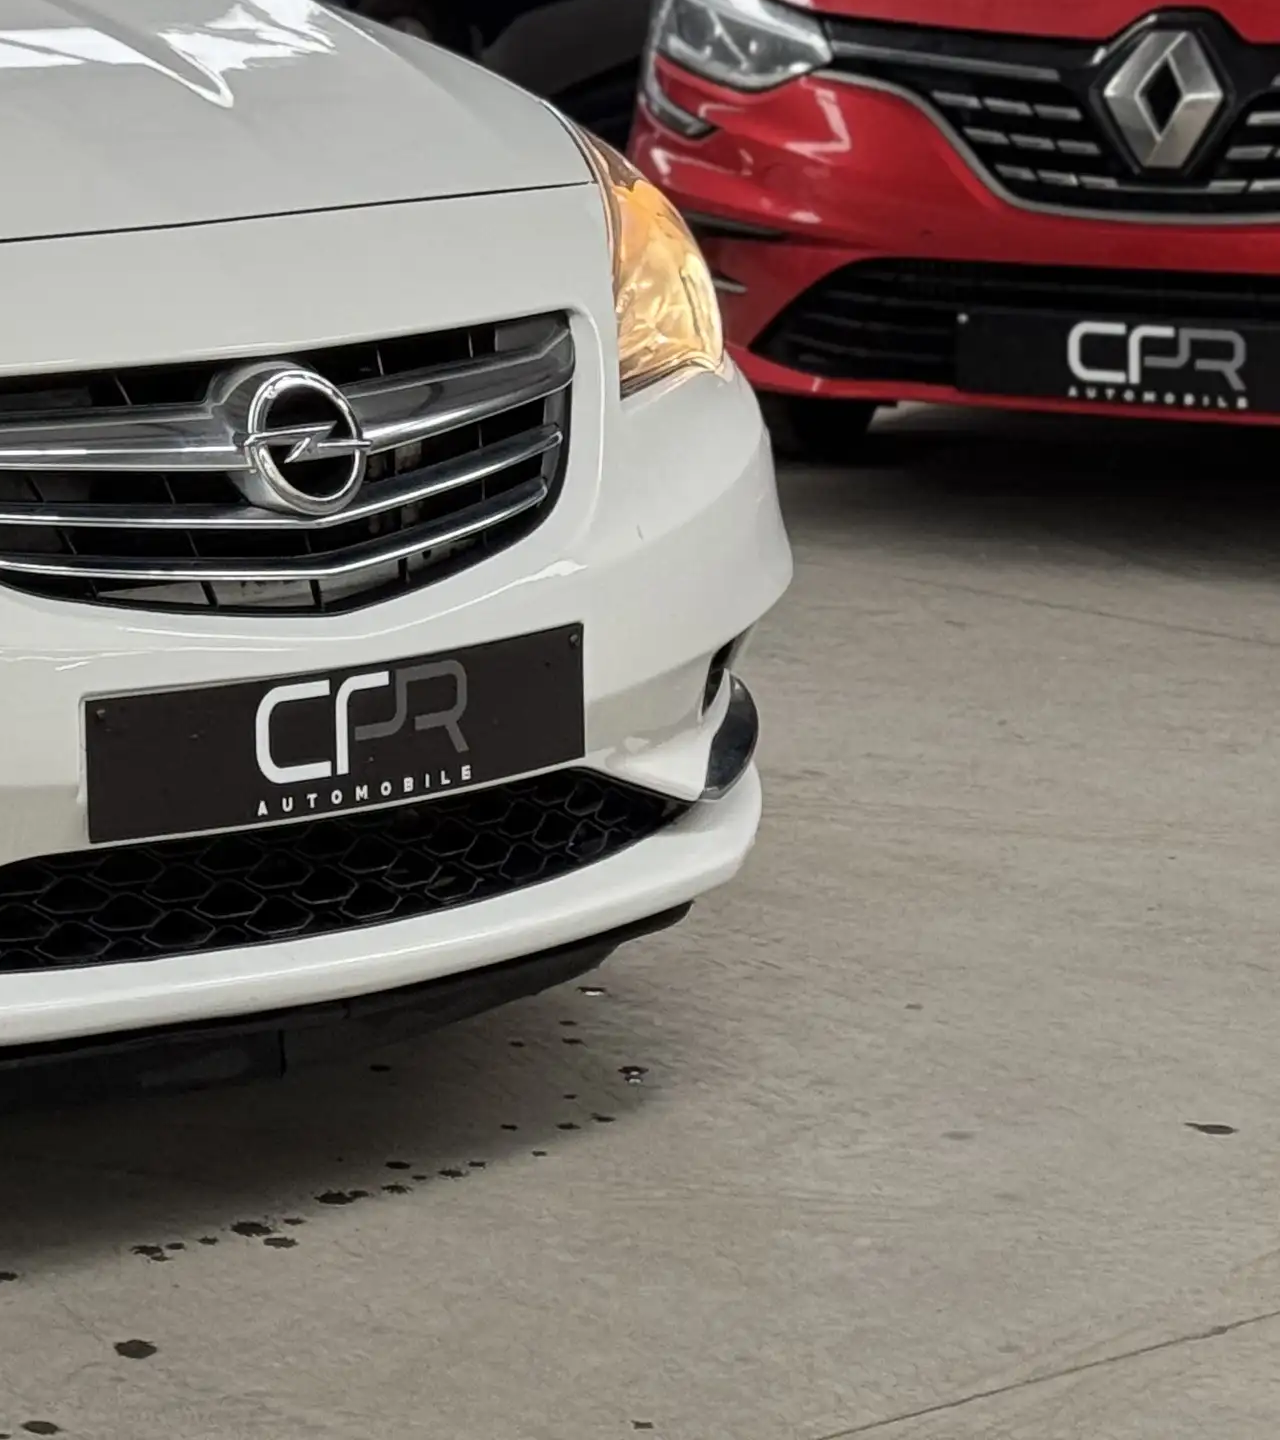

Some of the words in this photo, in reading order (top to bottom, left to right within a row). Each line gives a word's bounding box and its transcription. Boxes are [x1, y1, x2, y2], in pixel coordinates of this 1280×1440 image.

[1067, 321, 1246, 391] CPR
[256, 660, 468, 784] CPR
[257, 765, 472, 816] AUTOMOBILE
